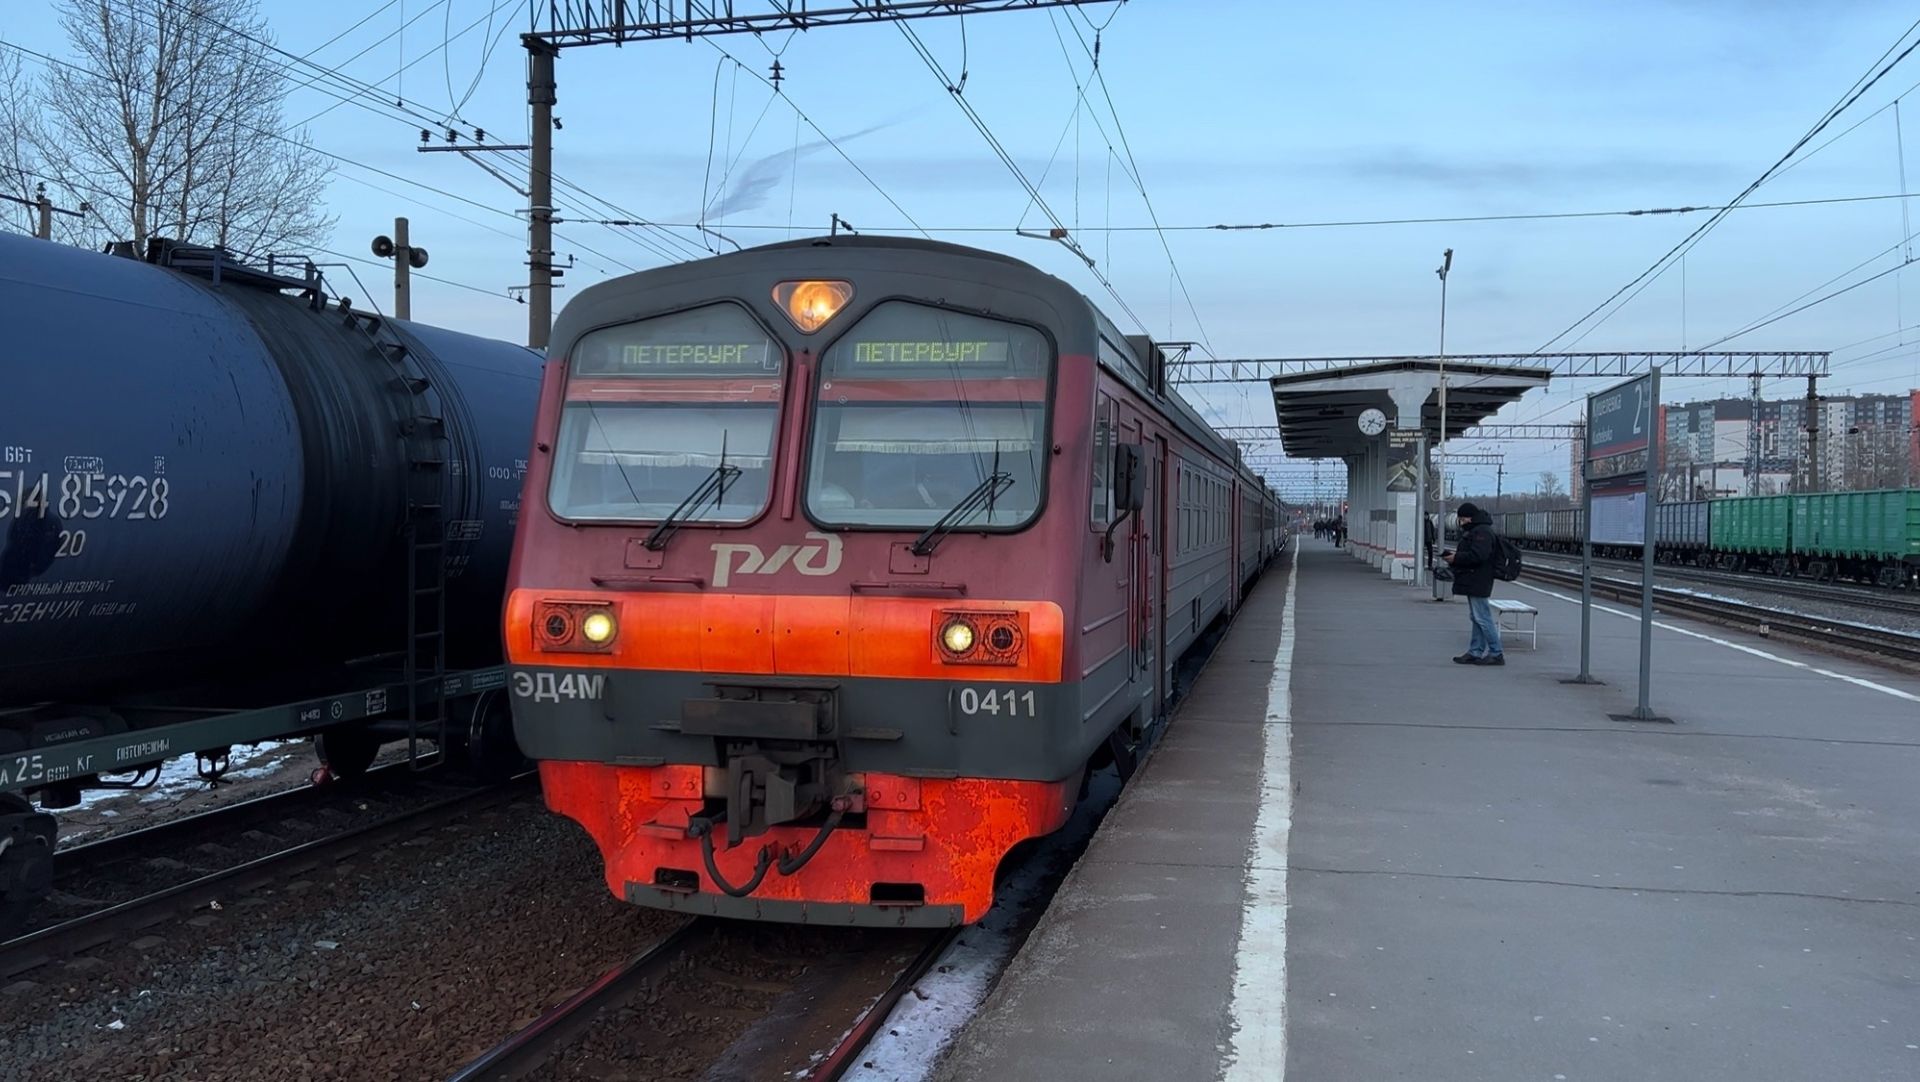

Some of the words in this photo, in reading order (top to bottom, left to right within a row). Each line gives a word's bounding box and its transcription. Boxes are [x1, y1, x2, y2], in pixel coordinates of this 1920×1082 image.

[623, 344, 750, 364] ПЕТЕРБУРГ
[856, 341, 988, 362] ПЕТЕРБУРГ
[1633, 383, 1643, 435] 2
[58, 473, 169, 520] 85928
[54, 530, 86, 558] 20
[6, 580, 63, 598] СРОЧНЫЙ
[62, 579, 115, 595] ВОЗВРАТ
[513, 672, 602, 702] ЭД4М
[960, 688, 1035, 716] 0411
[15, 755, 44, 783] 25
[47, 765, 70, 783] 600
